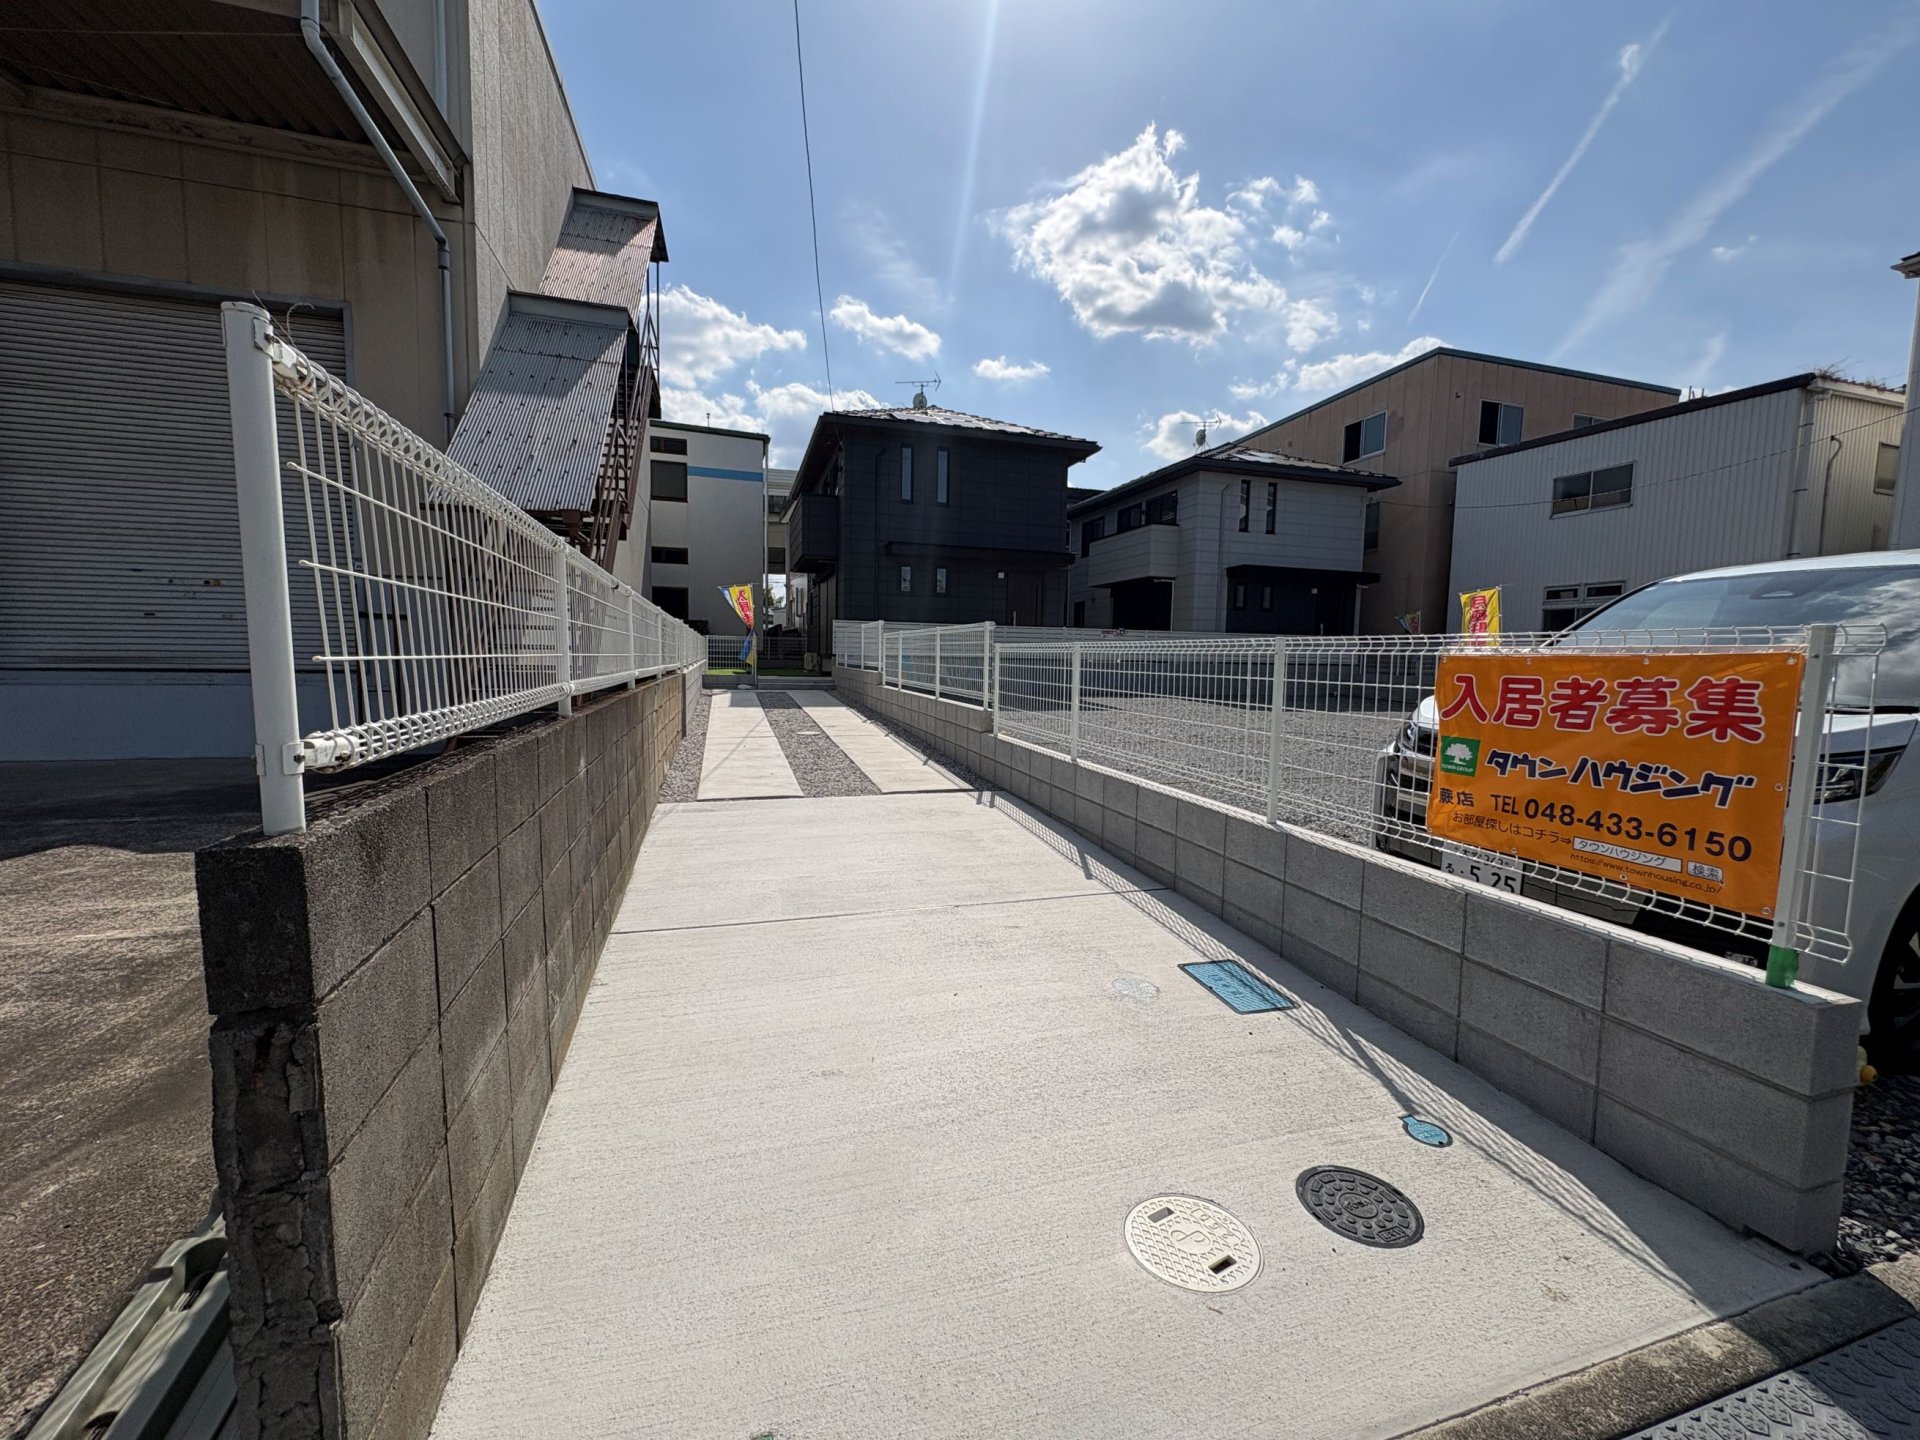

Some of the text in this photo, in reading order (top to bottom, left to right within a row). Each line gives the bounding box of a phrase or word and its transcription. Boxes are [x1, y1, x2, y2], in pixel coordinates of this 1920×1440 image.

[1440, 673, 1766, 744] 入居者募集
[1439, 788, 1752, 862] 蕨店 TEL 048-433-6150
[1570, 853, 1722, 894] https://www.townhousing.co.jp/
[1577, 839, 1667, 867] タウンハウジング
[1692, 863, 1721, 880] 検索
